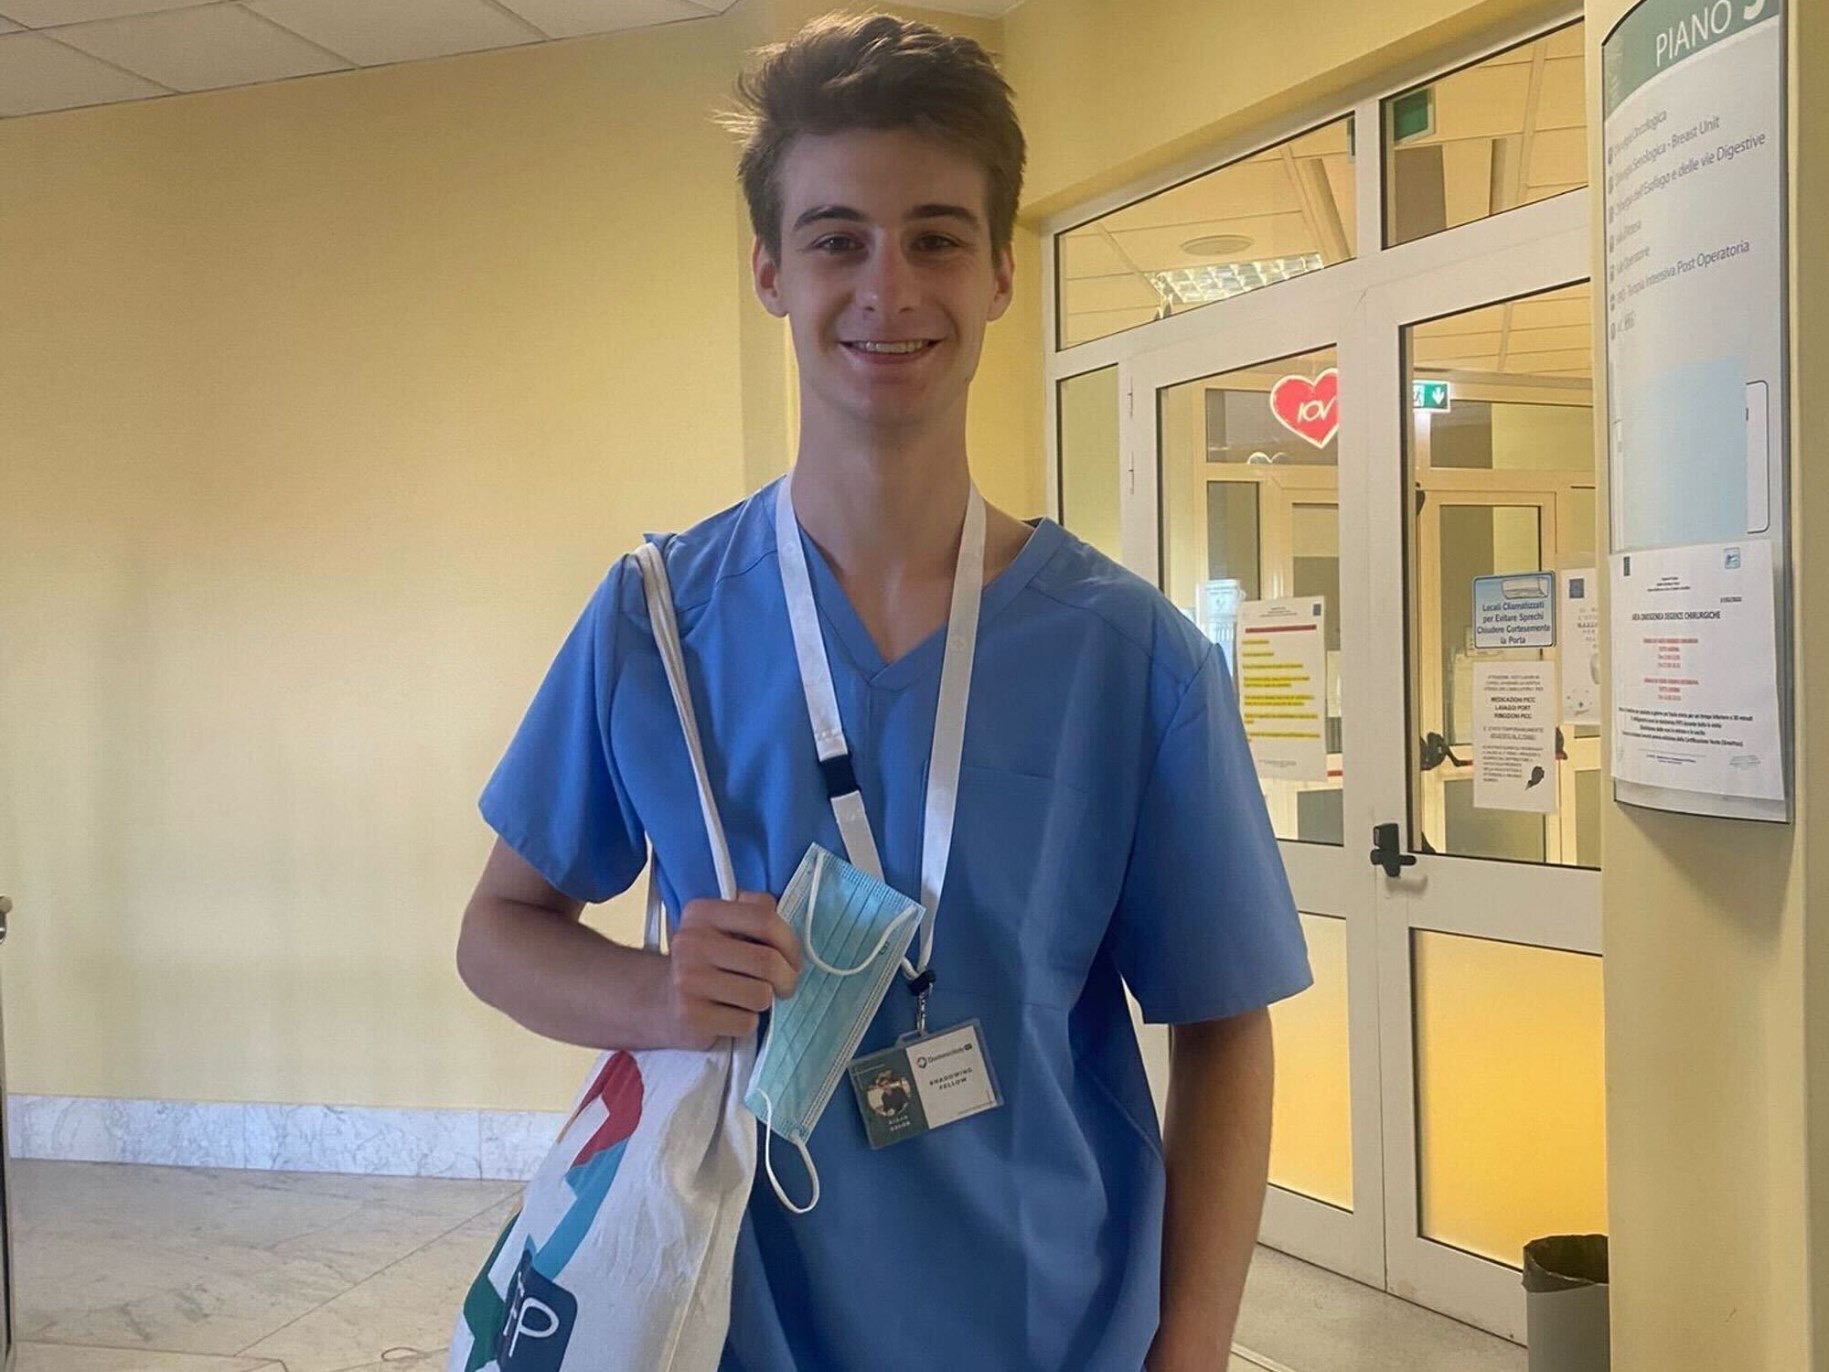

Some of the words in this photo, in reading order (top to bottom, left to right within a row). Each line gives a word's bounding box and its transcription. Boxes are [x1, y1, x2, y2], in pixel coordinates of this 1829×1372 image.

[1656, 0, 1732, 67] PIANO
[1671, 126, 1698, 149] Breast
[1699, 115, 1721, 135] Unit
[1678, 157, 1699, 178] delle
[1700, 151, 1715, 167] vie
[1716, 133, 1766, 161] Digestive
[1677, 258, 1696, 275] Post
[1697, 240, 1750, 268] Operatoria
[1483, 615, 1493, 624] per
[1495, 614, 1517, 622] Evitare
[1519, 612, 1544, 622] Sprechi
[1506, 624, 1551, 633] Cortesemente
[1508, 636, 1526, 644] Porta
